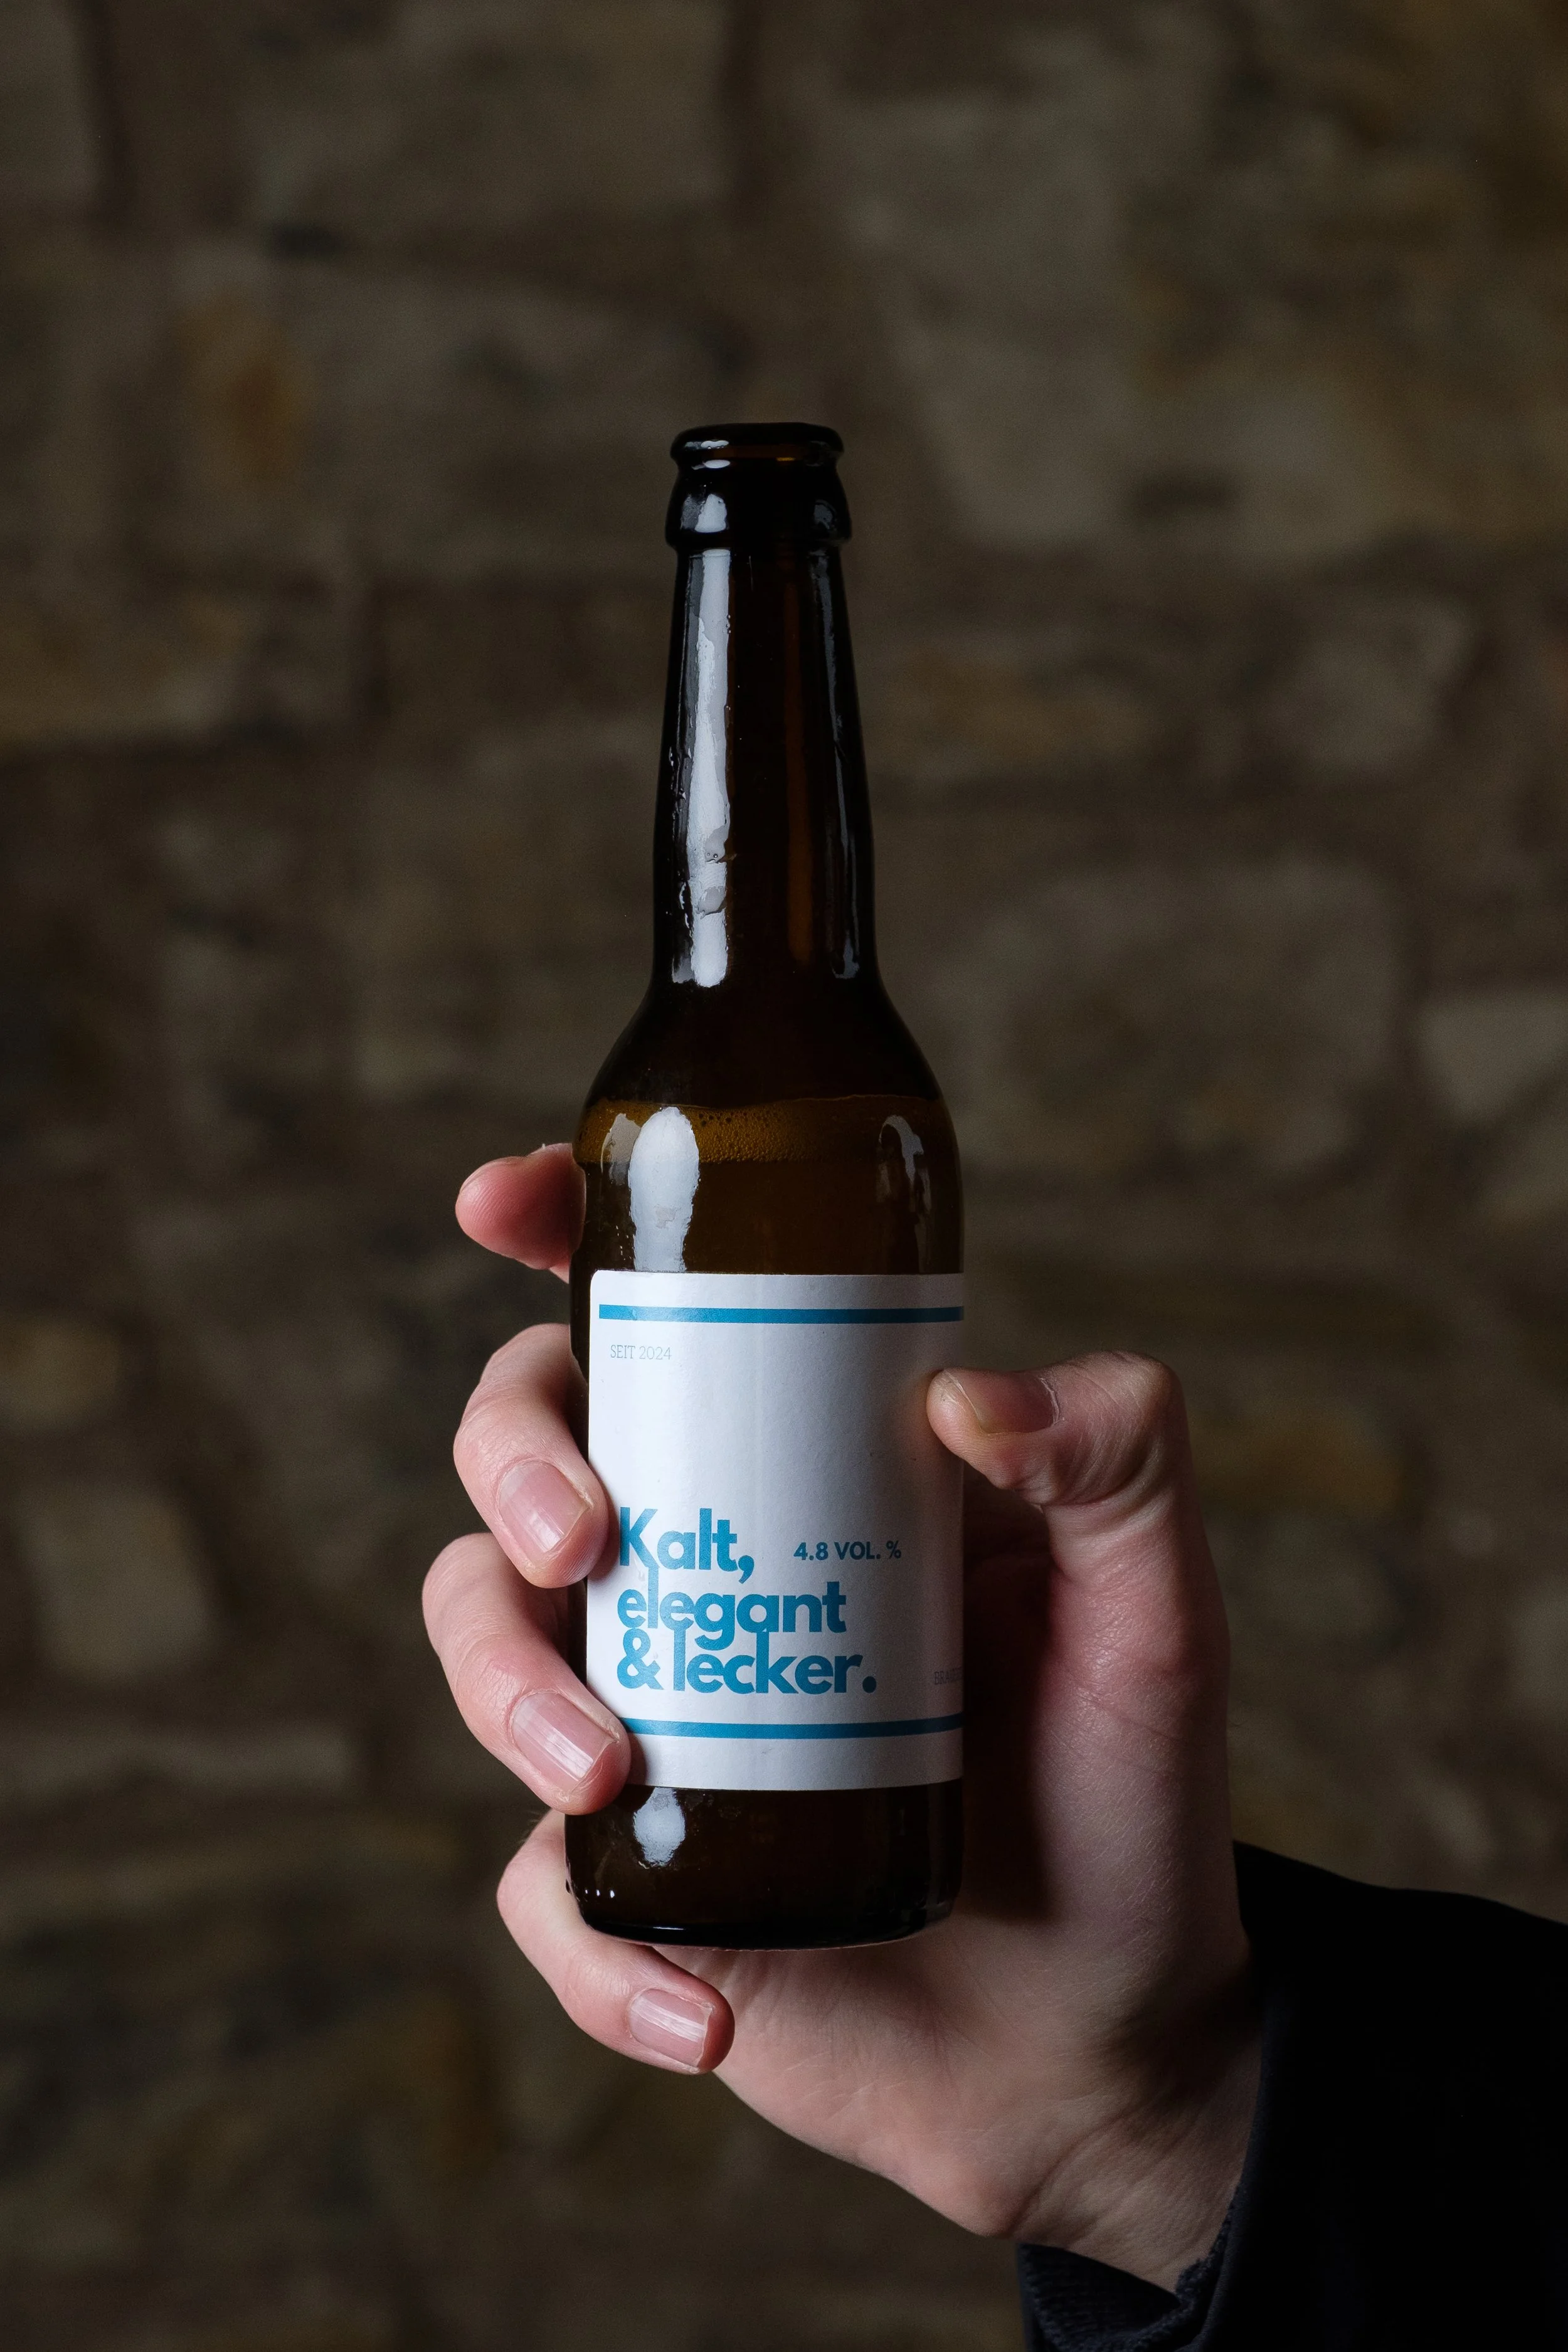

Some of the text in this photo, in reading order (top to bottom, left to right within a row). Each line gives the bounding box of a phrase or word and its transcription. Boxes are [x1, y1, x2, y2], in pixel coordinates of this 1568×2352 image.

[610, 1344, 672, 1360] SEIT 2024
[620, 1507, 755, 1584] Kalt,
[793, 1540, 901, 1560] 4.8 VOL. %
[617, 1567, 847, 1651] elegant
[617, 1628, 877, 1694] & lecker.
